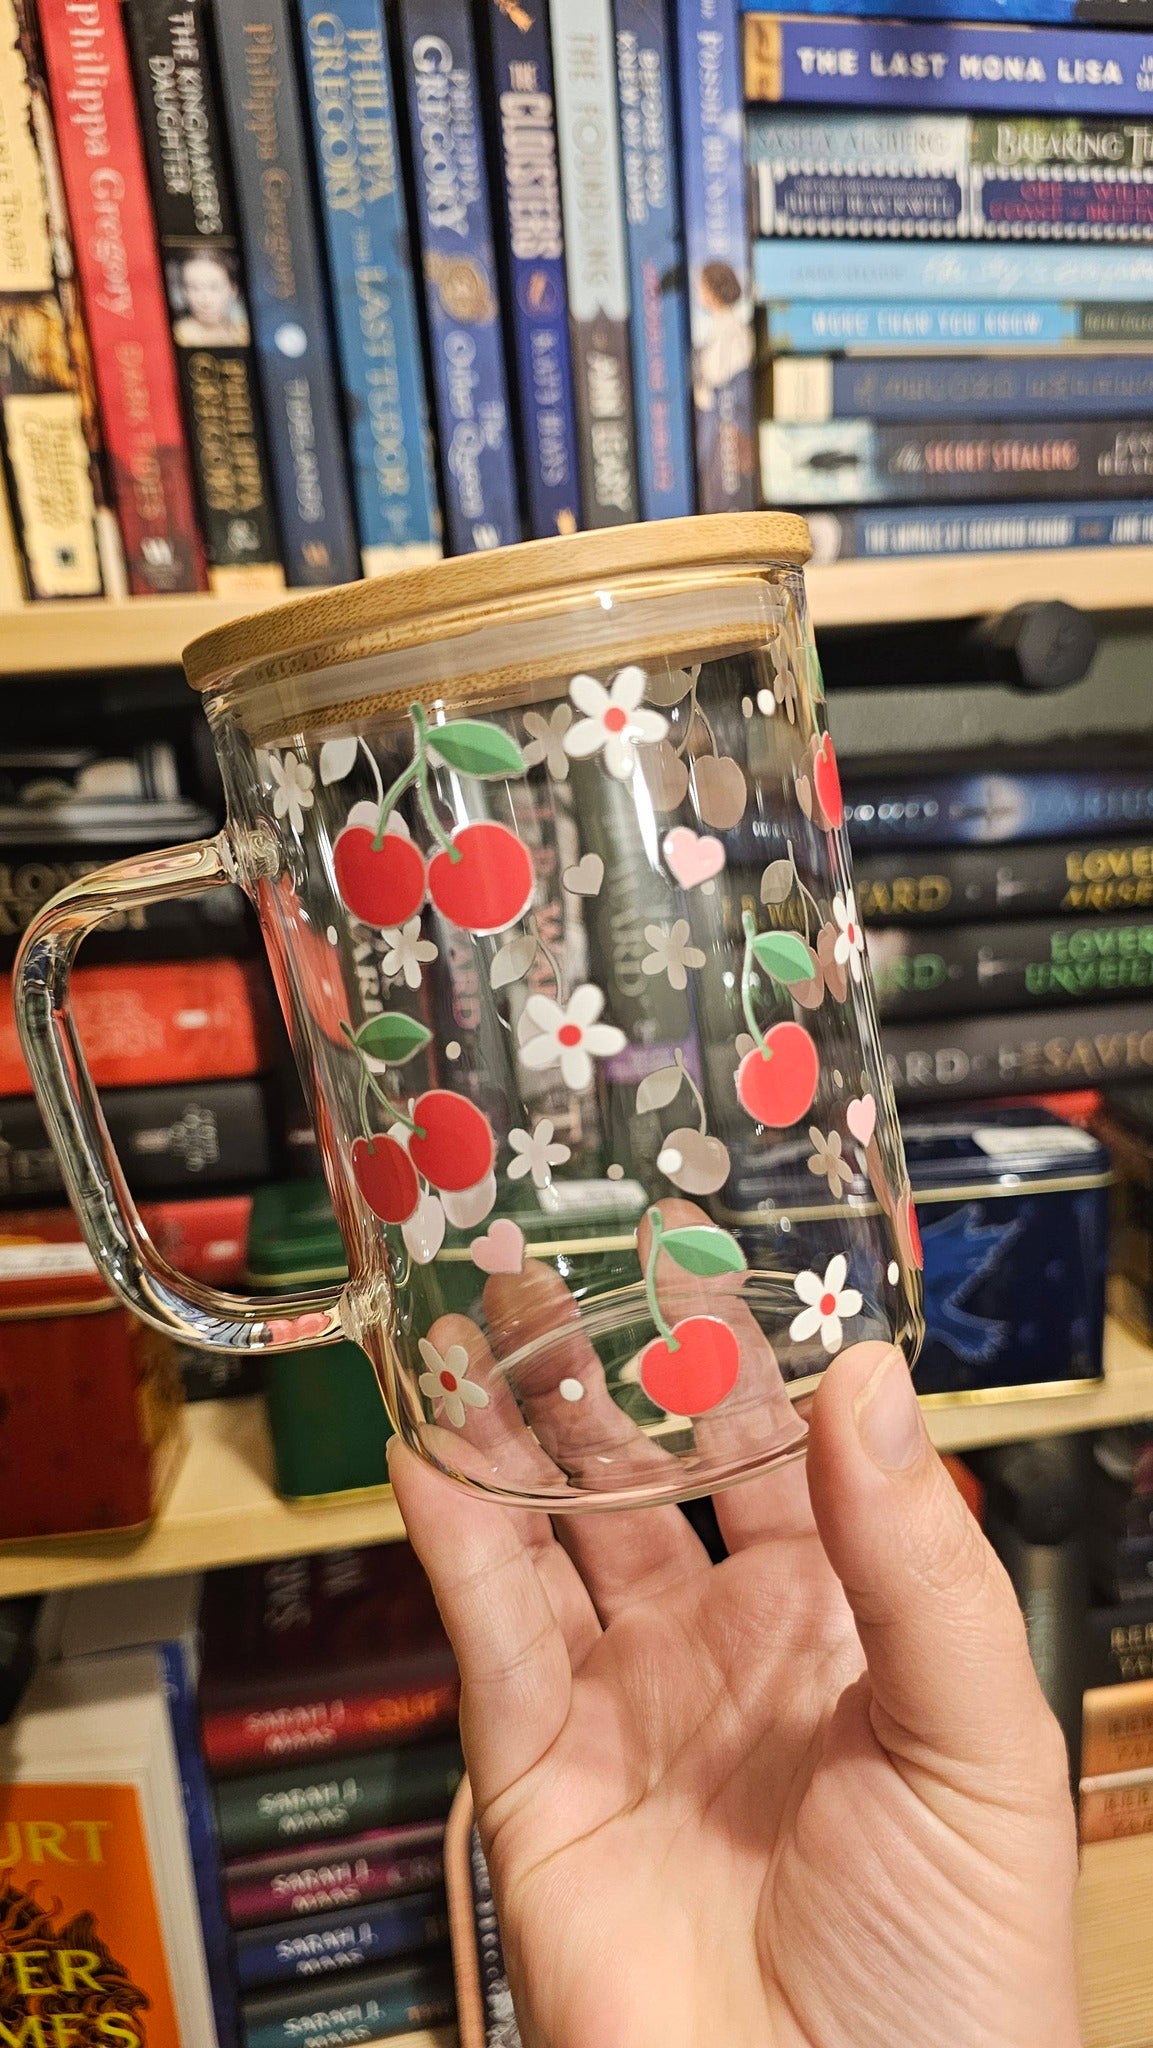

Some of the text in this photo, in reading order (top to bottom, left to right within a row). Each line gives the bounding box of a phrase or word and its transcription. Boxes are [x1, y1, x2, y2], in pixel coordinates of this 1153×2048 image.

[167, 10, 200, 61] THE
[797, 46, 1124, 86] THE LAST MONA LISA
[149, 54, 193, 194] DAUGHTER
[307, 12, 364, 219] GREGORY
[346, 28, 395, 203] PHILIPPA
[412, 34, 470, 238] GREGORY
[993, 122, 1125, 166] BREAKING
[65, 2, 135, 319] Philippa Gregory
[501, 92, 562, 260] CLOISTERS
[247, 1702, 328, 1733] SARAH
[264, 1723, 337, 1755] MAAS
[257, 1779, 340, 1819] SARAH
[278, 1803, 350, 1837] MAAS
[270, 1861, 351, 1899] SARAH
[291, 1884, 362, 1914] MAAS
[275, 1925, 356, 1963] SARAH
[296, 1947, 365, 1976] MAAS
[0, 1949, 107, 1995] ER
[283, 2003, 362, 2038] SARAH
[303, 2024, 373, 2048] MAAS
